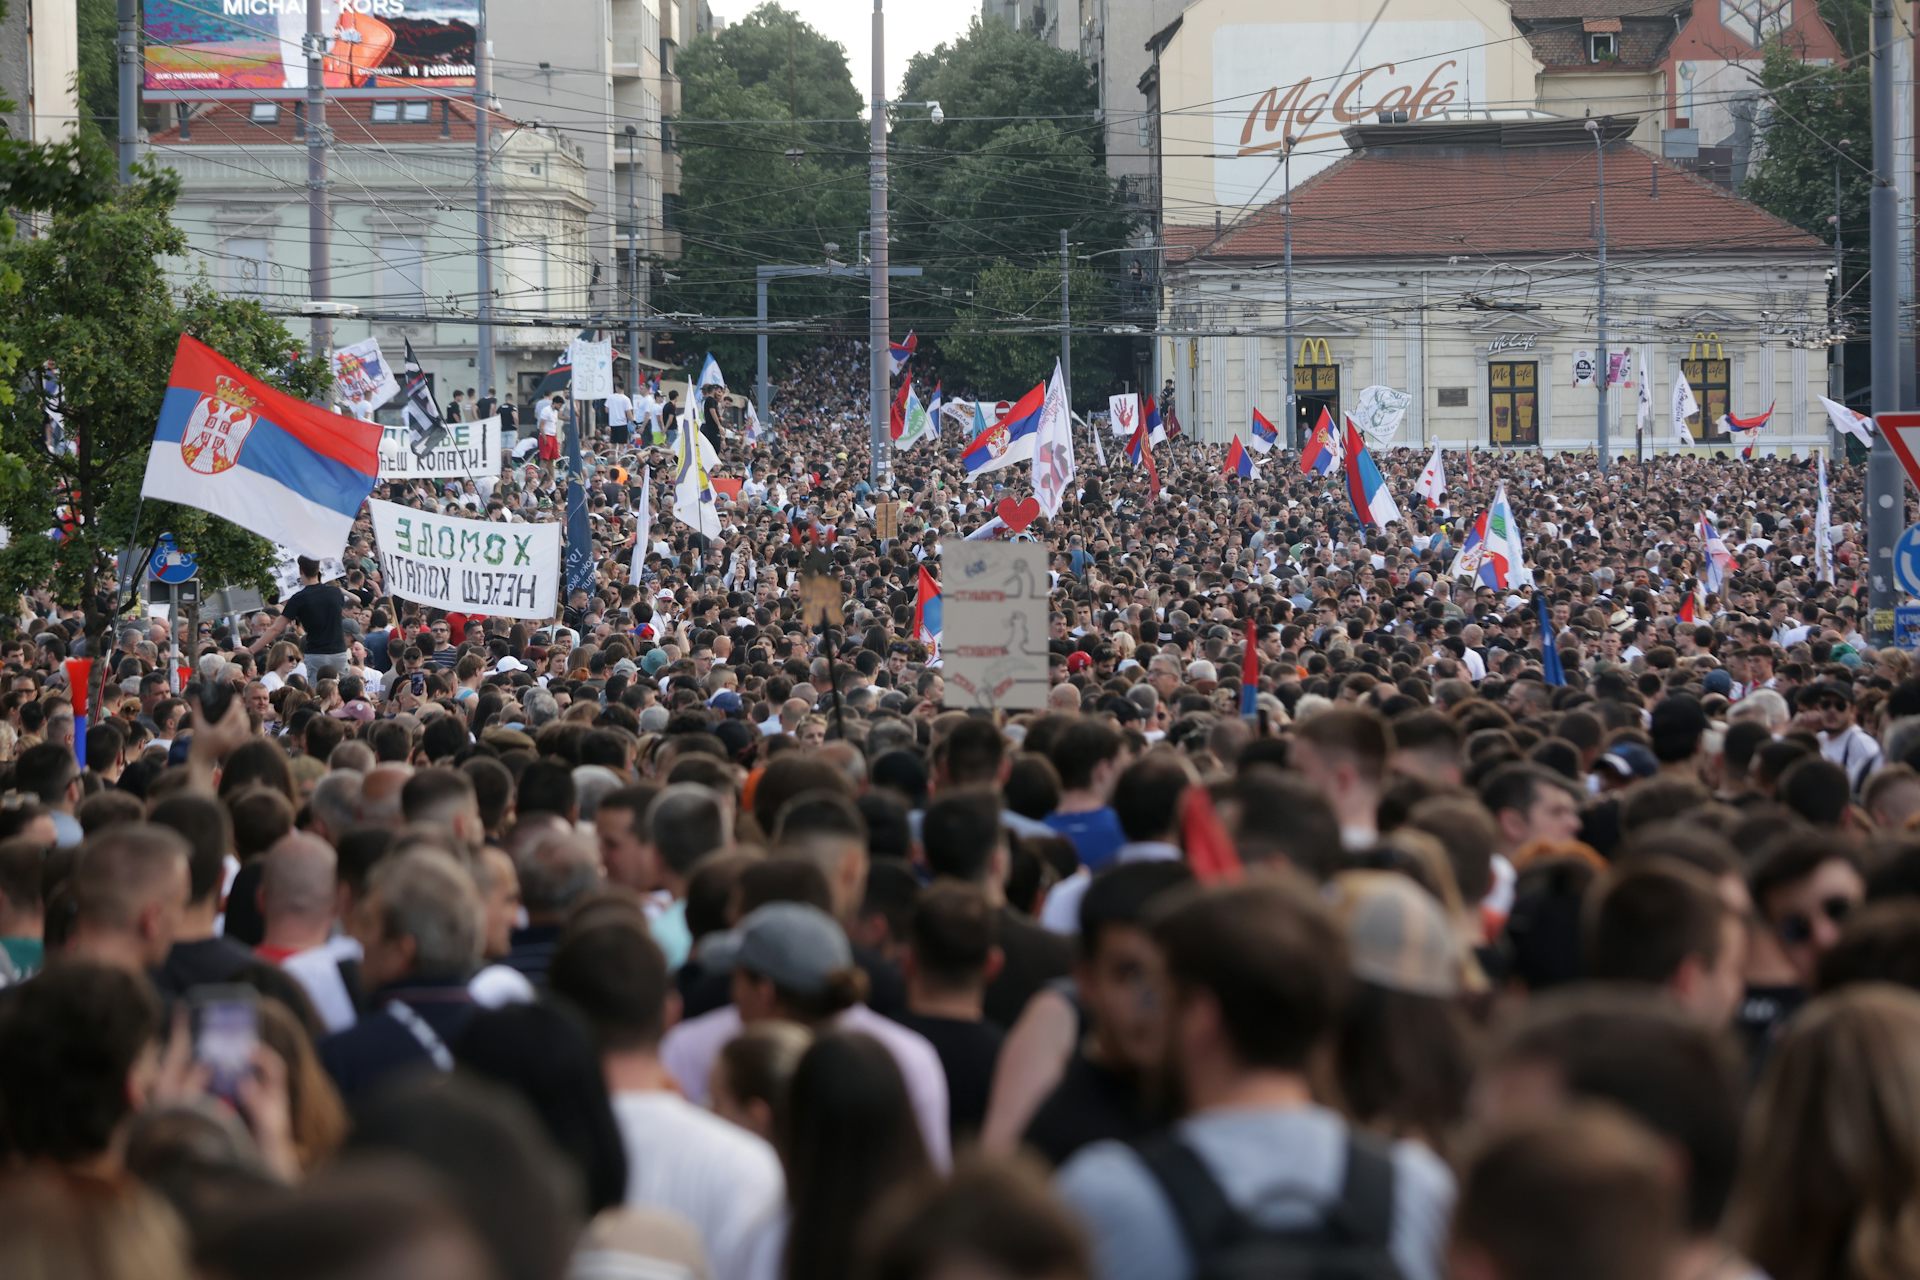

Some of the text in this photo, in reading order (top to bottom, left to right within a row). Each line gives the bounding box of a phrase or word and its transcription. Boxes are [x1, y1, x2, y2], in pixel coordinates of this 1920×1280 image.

[223, 0, 405, 15] MICHAL KORS
[1240, 60, 1459, 153] McCafé
